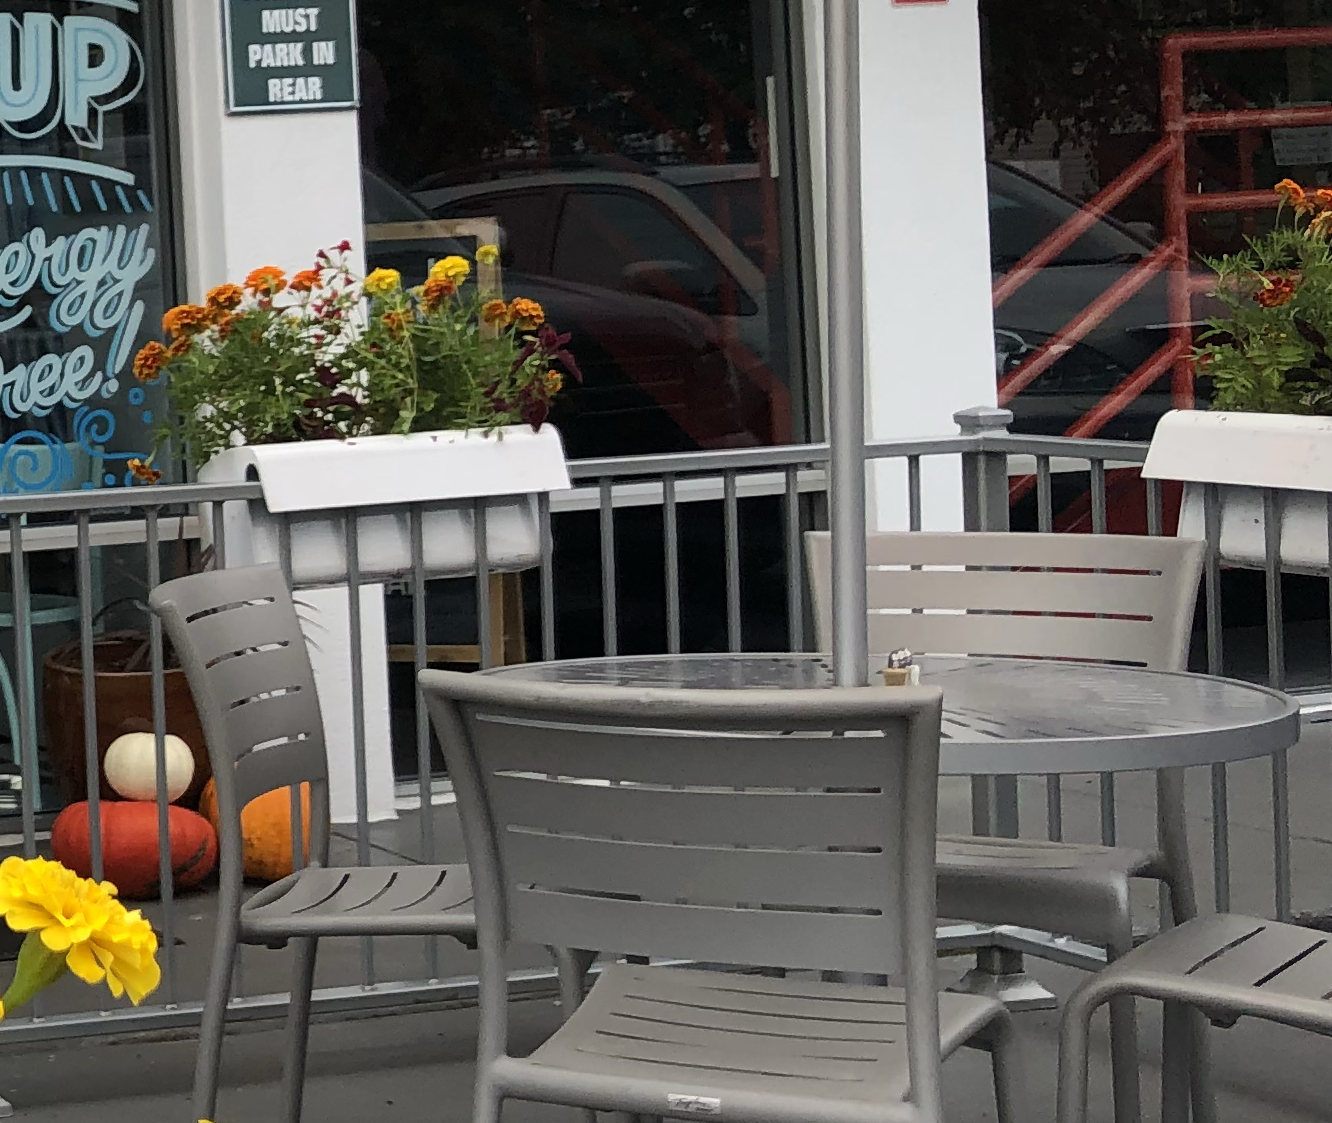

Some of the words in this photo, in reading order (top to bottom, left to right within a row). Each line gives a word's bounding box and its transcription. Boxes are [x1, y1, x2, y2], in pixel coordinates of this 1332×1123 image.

[261, 7, 320, 33] MUST
[248, 42, 305, 68] PARK
[312, 41, 336, 64] IN
[267, 76, 322, 102] REAR
